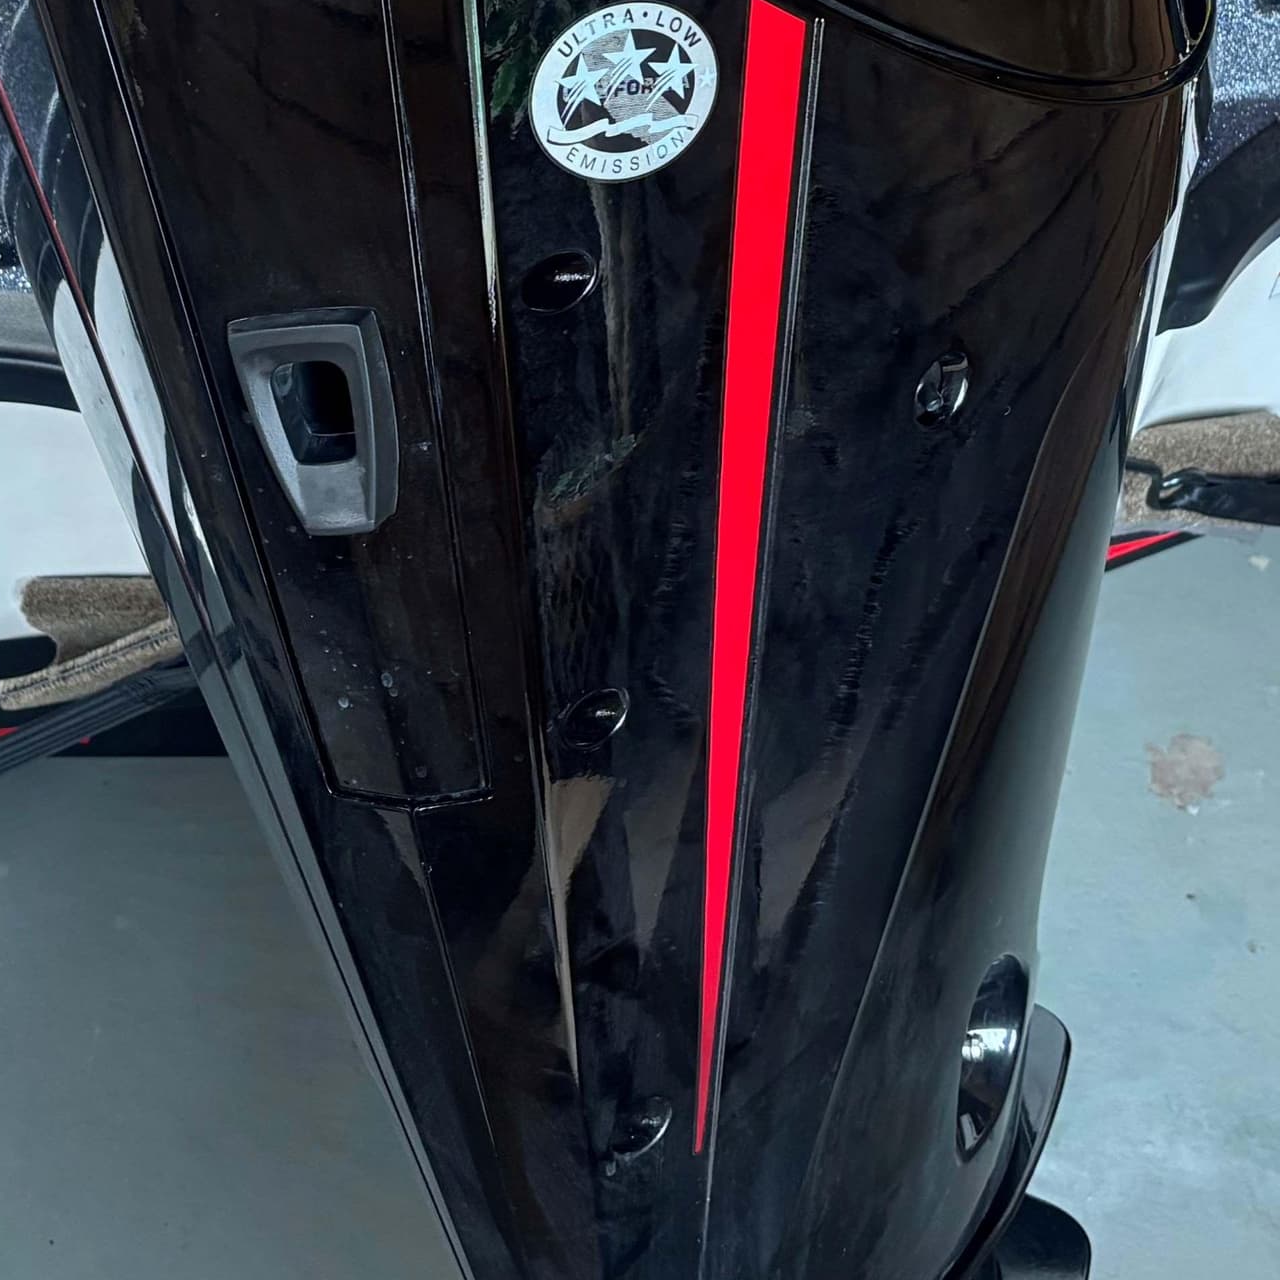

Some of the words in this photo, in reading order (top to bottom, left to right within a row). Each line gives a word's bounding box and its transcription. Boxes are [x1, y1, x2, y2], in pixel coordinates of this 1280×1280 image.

[557, 8, 634, 58] ULTRA
[656, 10, 702, 48] LOW
[566, 131, 684, 174] EMISSION
